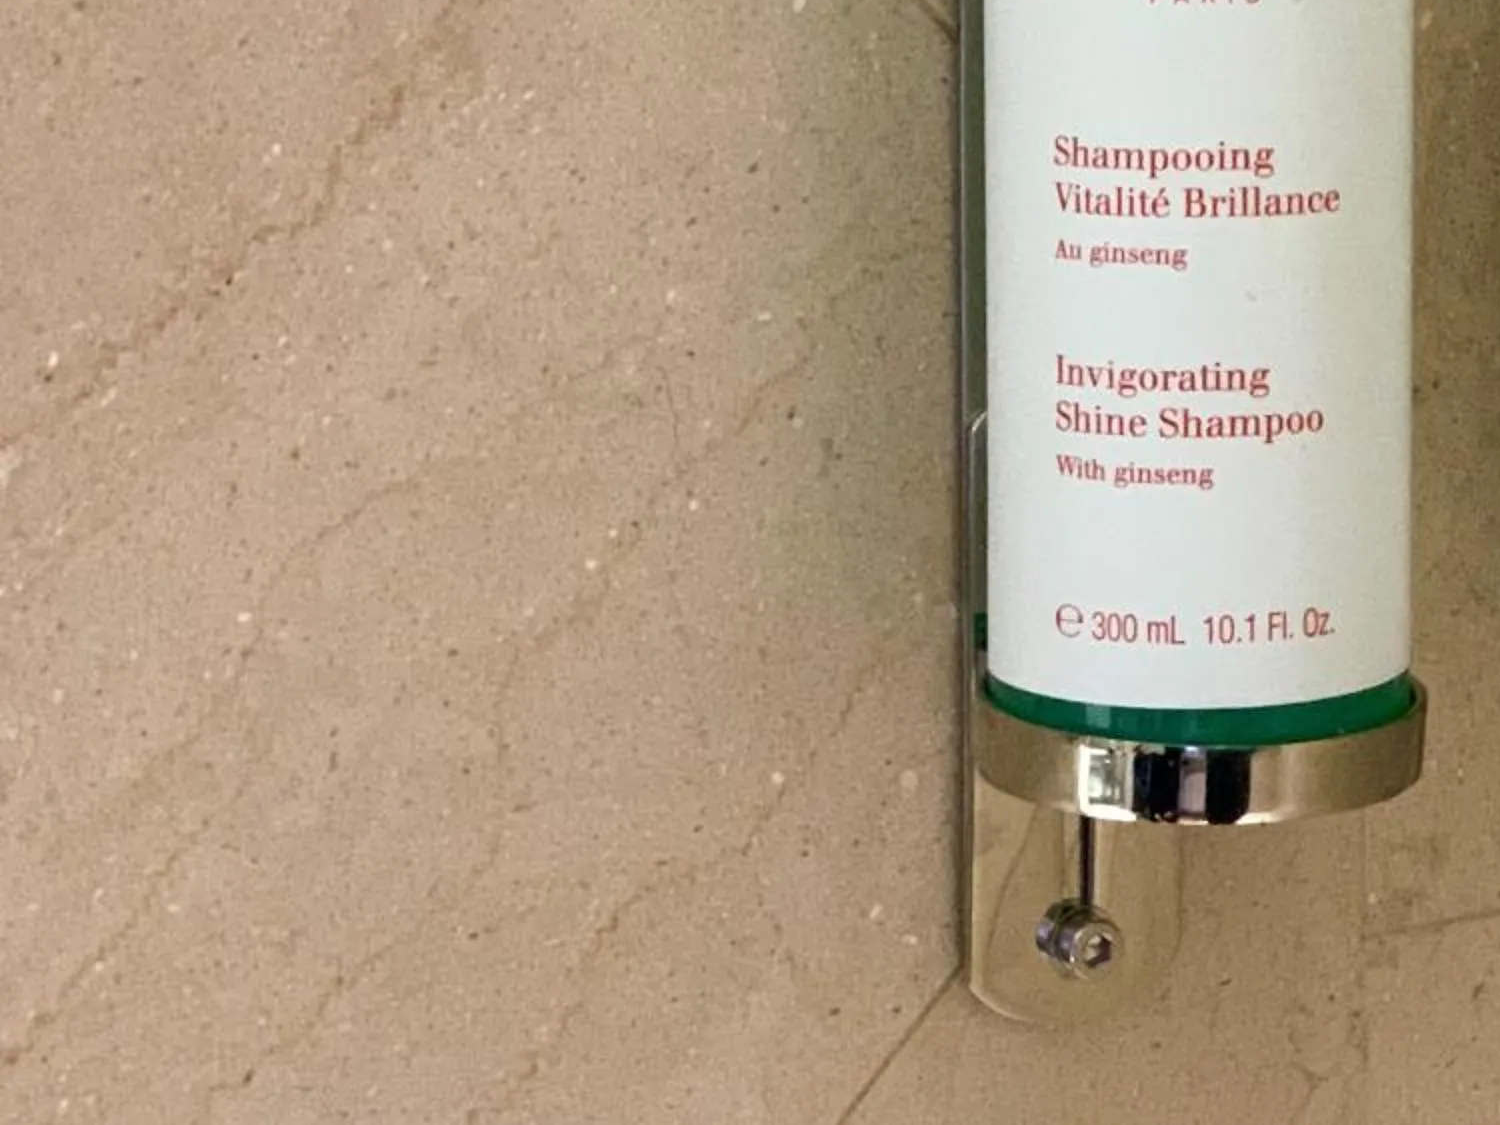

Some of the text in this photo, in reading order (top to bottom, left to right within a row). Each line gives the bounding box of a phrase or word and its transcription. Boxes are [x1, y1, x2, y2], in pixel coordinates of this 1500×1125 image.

[1054, 135, 1275, 178] Shampooing
[1055, 182, 1341, 218] Vitalité Brillance
[1055, 239, 1188, 270] Au ginseng
[1055, 354, 1271, 398] Invigorating
[1055, 400, 1324, 444] Shine Shampoo
[1056, 454, 1215, 490] With ginseng
[1091, 611, 1138, 642] 300
[1147, 616, 1185, 645] mL
[1203, 614, 1256, 644] 10.1
[1303, 607, 1335, 637] Oz.
